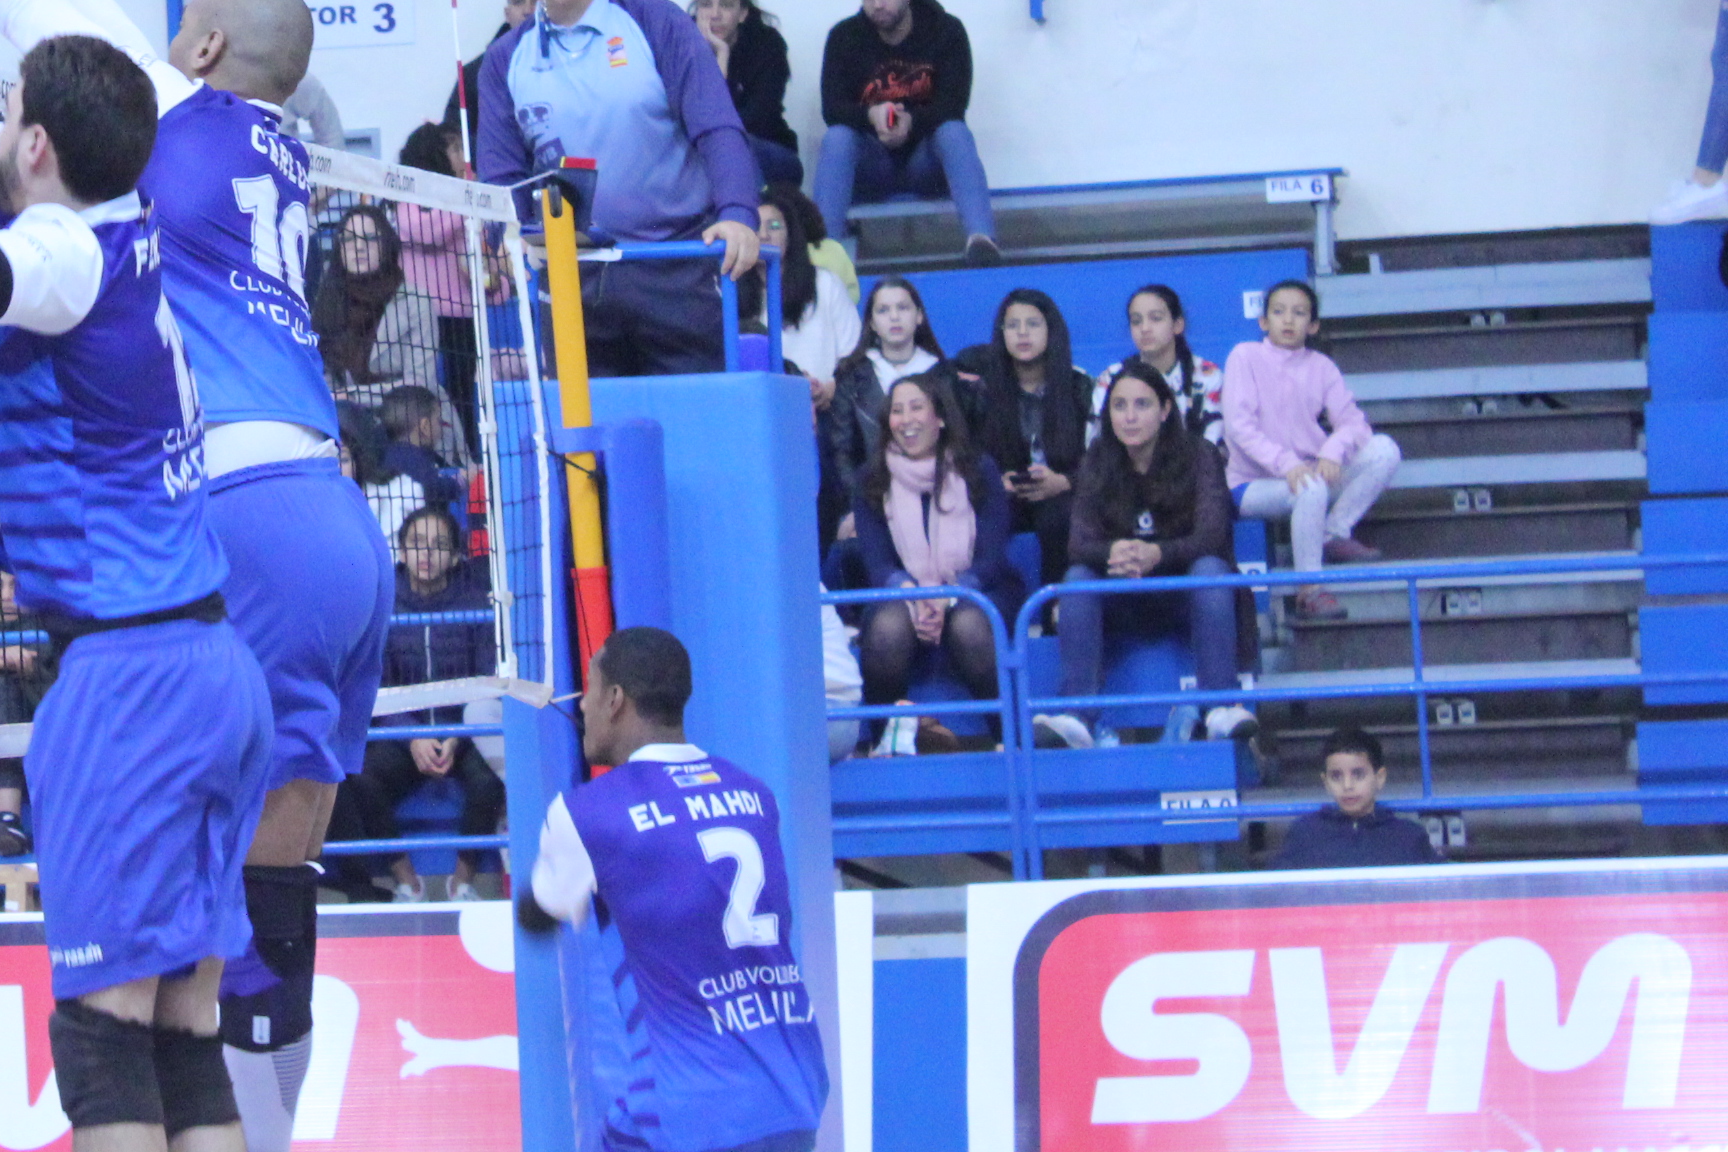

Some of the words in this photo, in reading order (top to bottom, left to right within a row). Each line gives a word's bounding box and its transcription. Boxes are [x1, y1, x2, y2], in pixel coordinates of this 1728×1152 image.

[373, 3, 397, 34] 3
[1271, 177, 1303, 192] FILA
[1310, 178, 1325, 196] 6
[628, 801, 676, 833] EL
[683, 789, 764, 822] MAHDI
[695, 826, 780, 950] 2
[1089, 931, 1693, 1125] SVM
